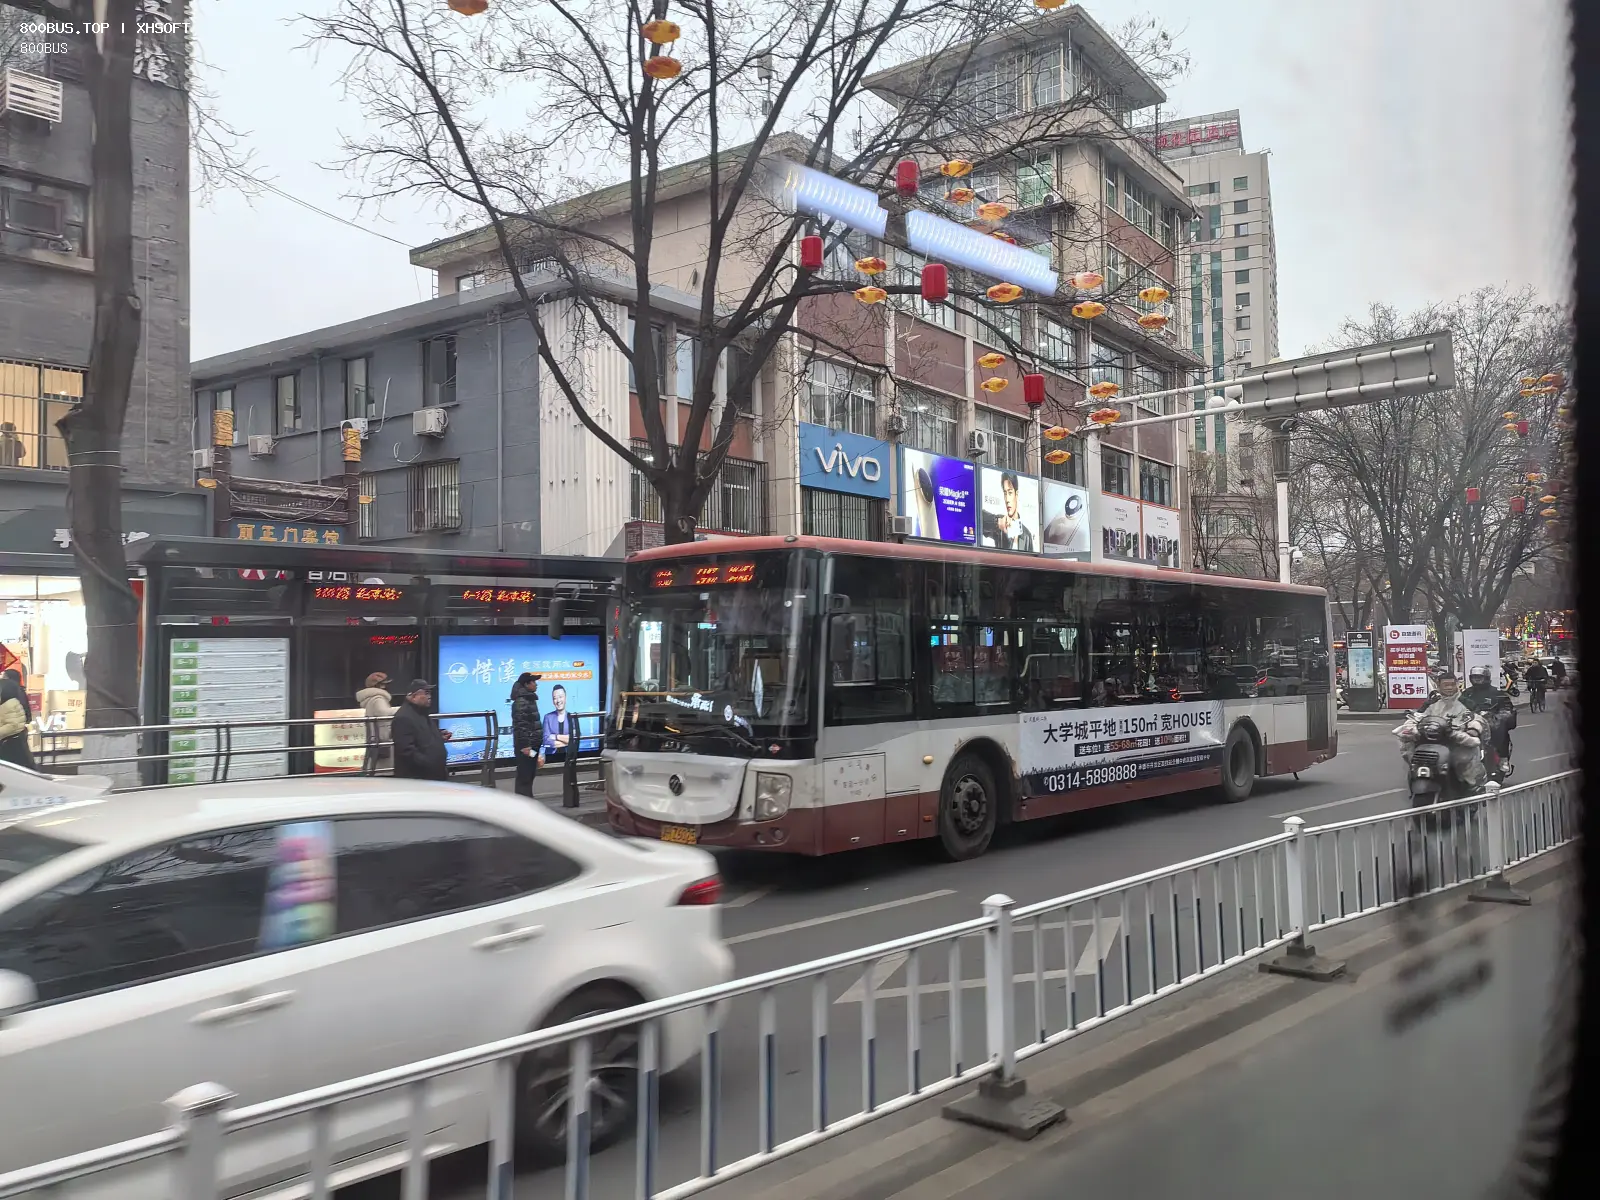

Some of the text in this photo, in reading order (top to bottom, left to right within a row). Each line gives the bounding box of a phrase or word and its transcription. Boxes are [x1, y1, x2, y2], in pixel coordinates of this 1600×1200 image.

[814, 443, 881, 482] vivo
[1043, 717, 1117, 744] 大学城平地
[1048, 763, 1138, 792] 0314-5898888
